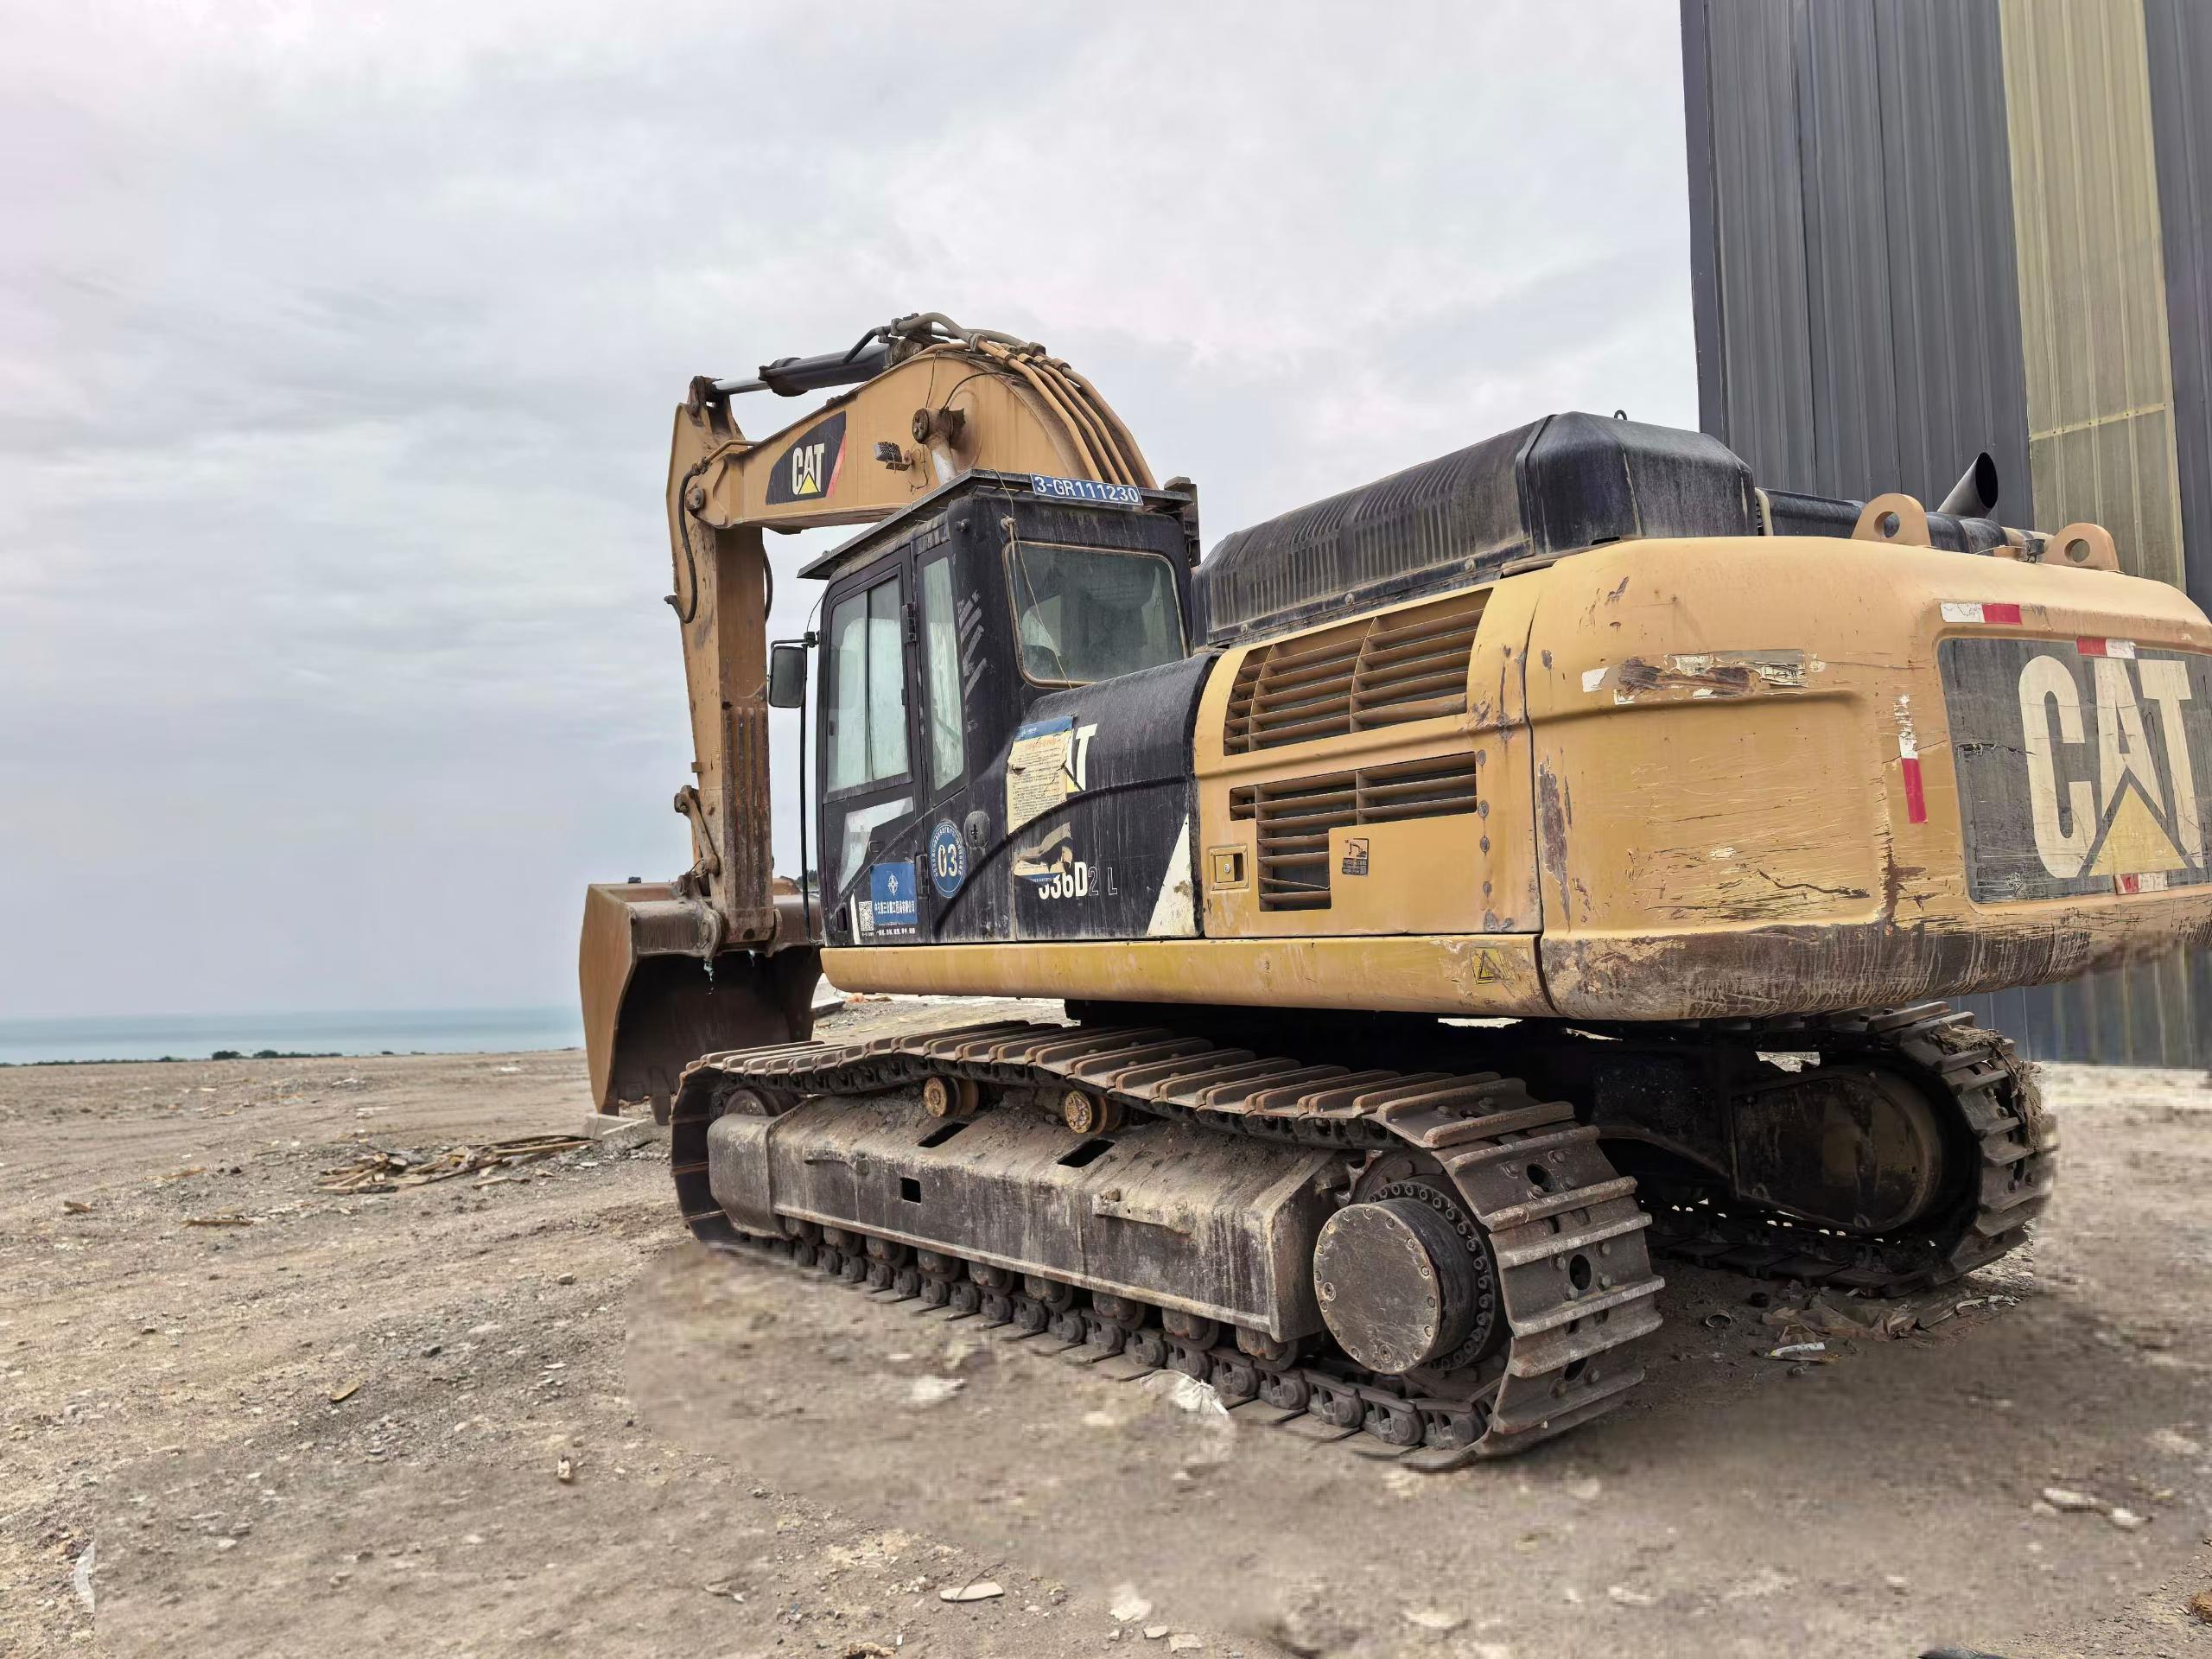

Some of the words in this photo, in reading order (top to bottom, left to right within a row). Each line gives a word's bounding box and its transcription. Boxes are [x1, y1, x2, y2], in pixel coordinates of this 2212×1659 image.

[792, 443, 825, 495] CAT
[1034, 476, 1139, 502] 3-GR111230
[2018, 654, 2204, 878] CAT
[938, 843, 957, 877] 03
